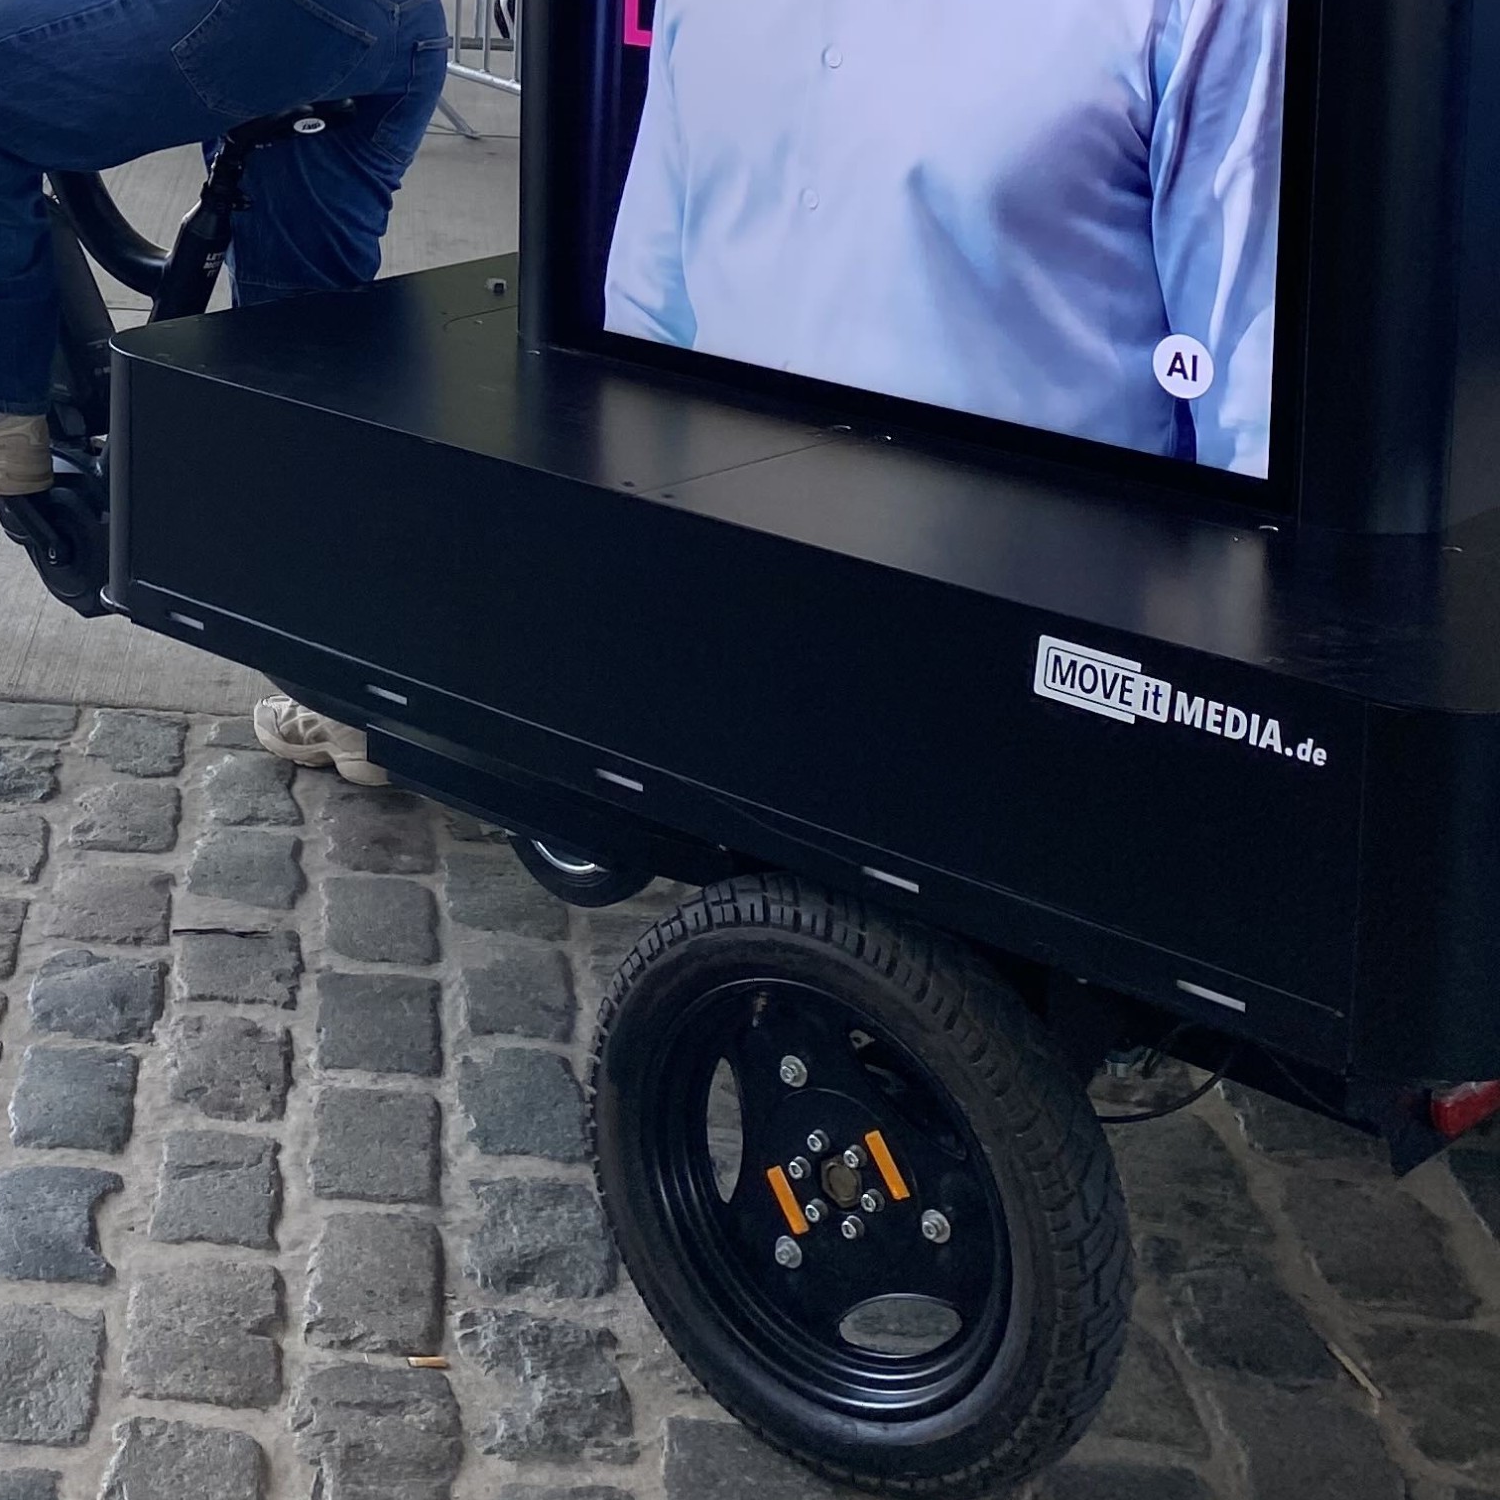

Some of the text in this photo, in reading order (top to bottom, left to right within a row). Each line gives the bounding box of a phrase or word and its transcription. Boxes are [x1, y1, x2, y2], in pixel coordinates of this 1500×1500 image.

[1167, 350, 1198, 382] AI
[1051, 653, 1327, 767] MOVE it MEDIA.de
